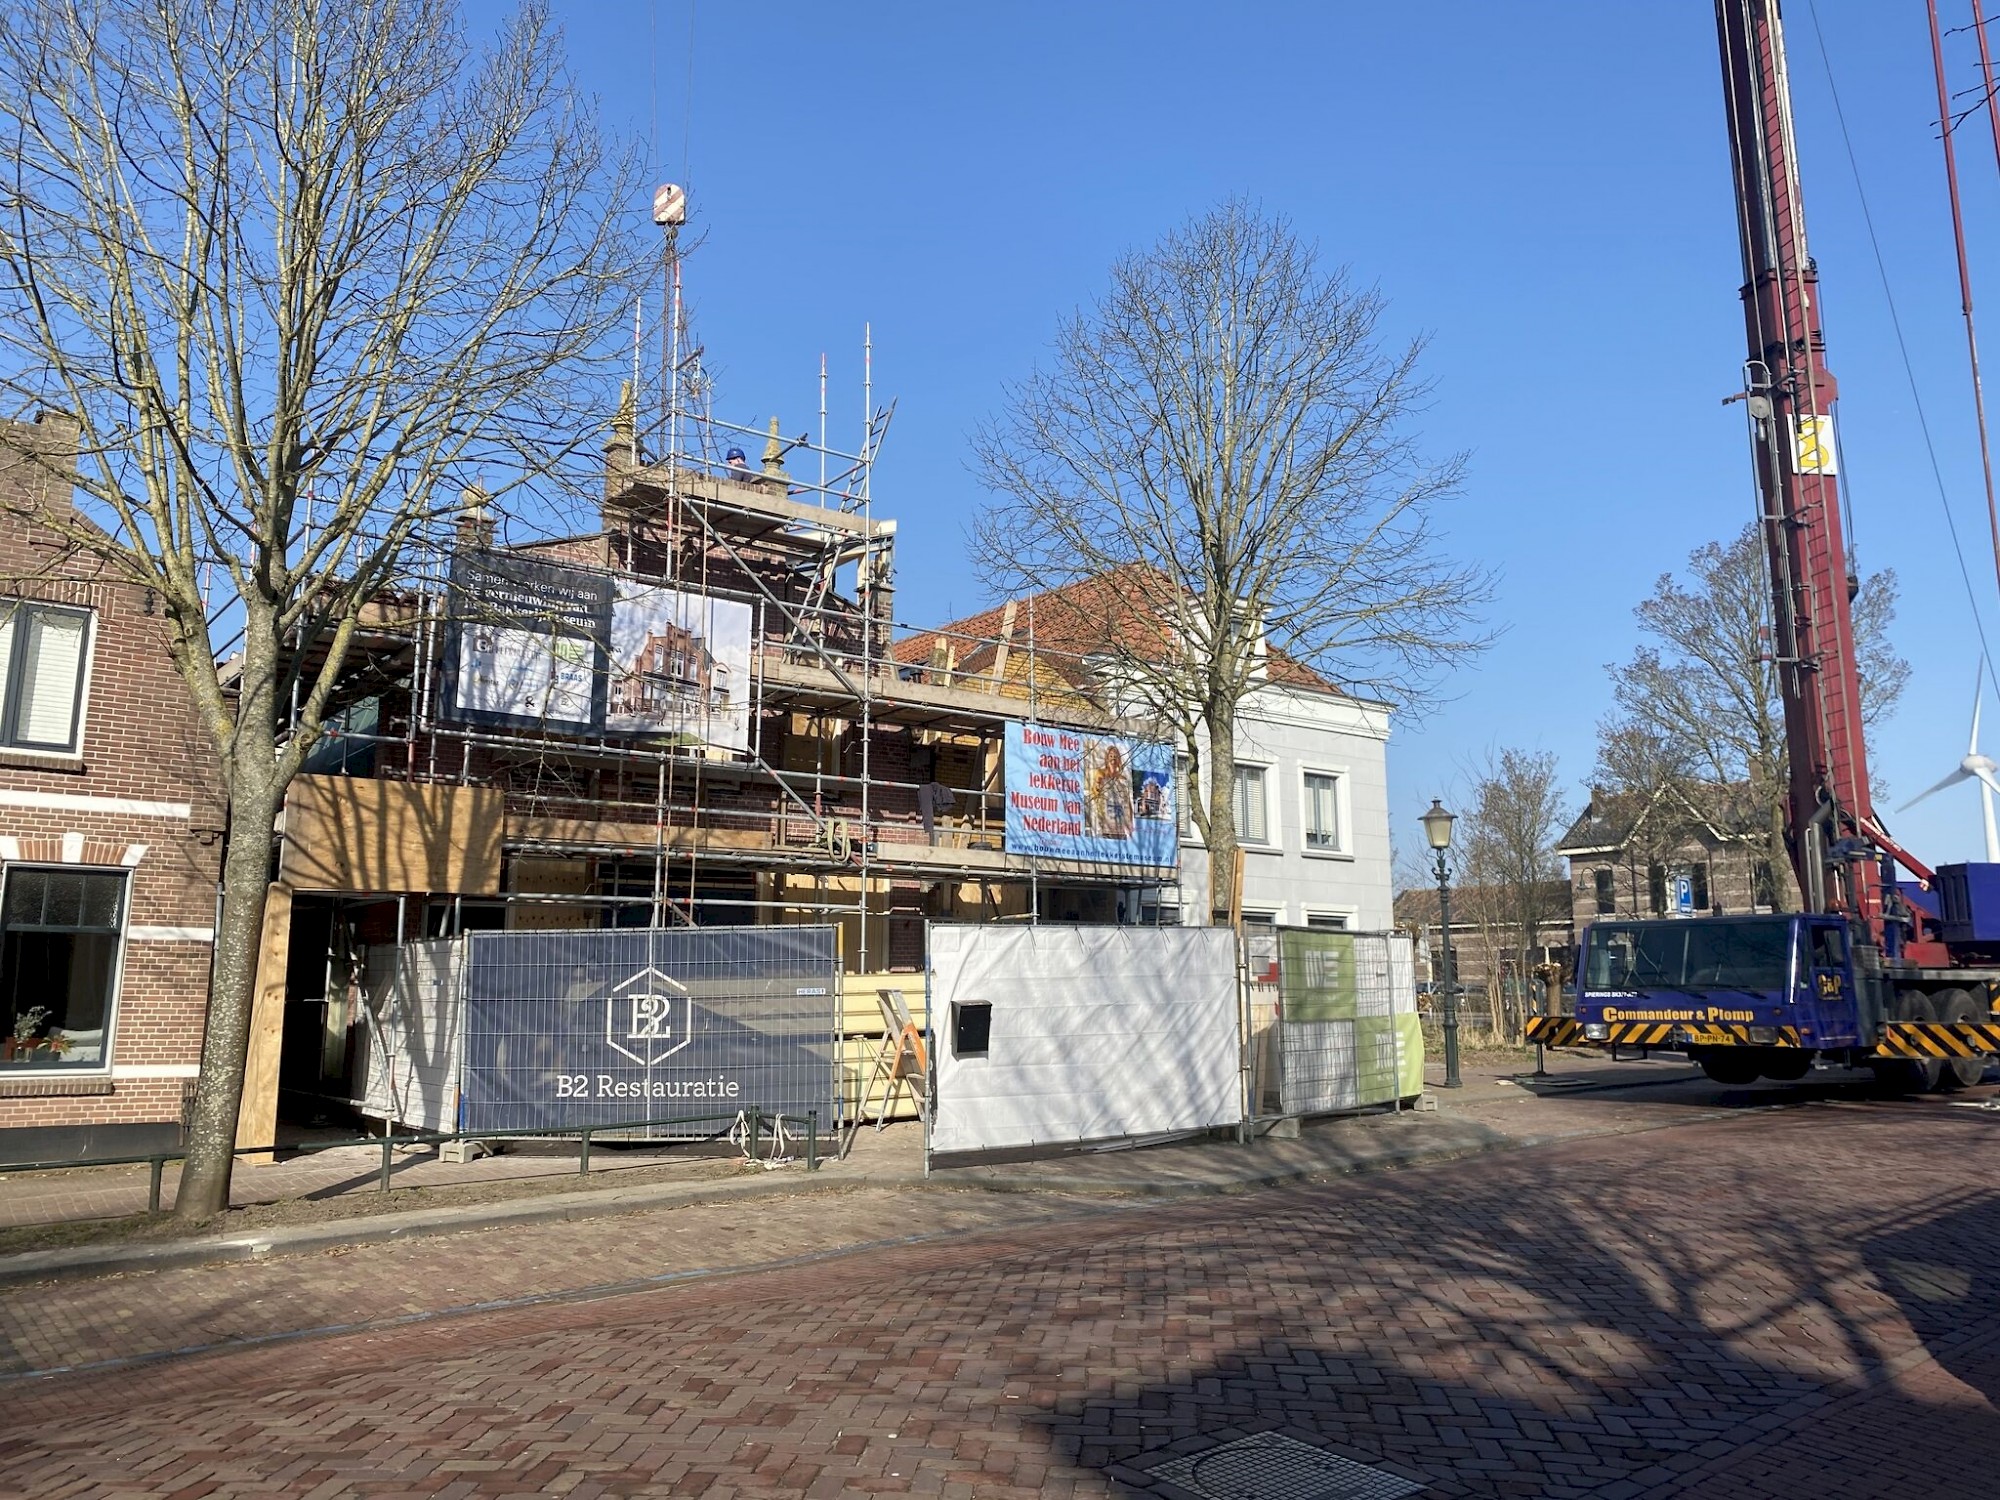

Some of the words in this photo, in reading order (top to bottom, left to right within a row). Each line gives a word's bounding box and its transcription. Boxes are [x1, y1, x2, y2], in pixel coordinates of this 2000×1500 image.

[466, 569, 508, 585] Samen
[559, 586, 575, 599] wij
[577, 590, 598, 601] aan
[1023, 728, 1055, 749] Bouw
[1059, 734, 1080, 751] Mee
[1039, 753, 1060, 770] aan
[1029, 773, 1081, 793] lekkerste
[1011, 791, 1058, 811] Museum
[1063, 801, 1081, 814] van
[1023, 815, 1081, 836] Nederland
[1680, 880, 1688, 899] P
[1603, 1007, 1694, 1022] Commandeur
[1696, 1010, 1705, 1020] &
[1707, 1007, 1754, 1022] Plomp
[555, 1075, 589, 1098] B2
[596, 1074, 740, 1098] Restauratie
